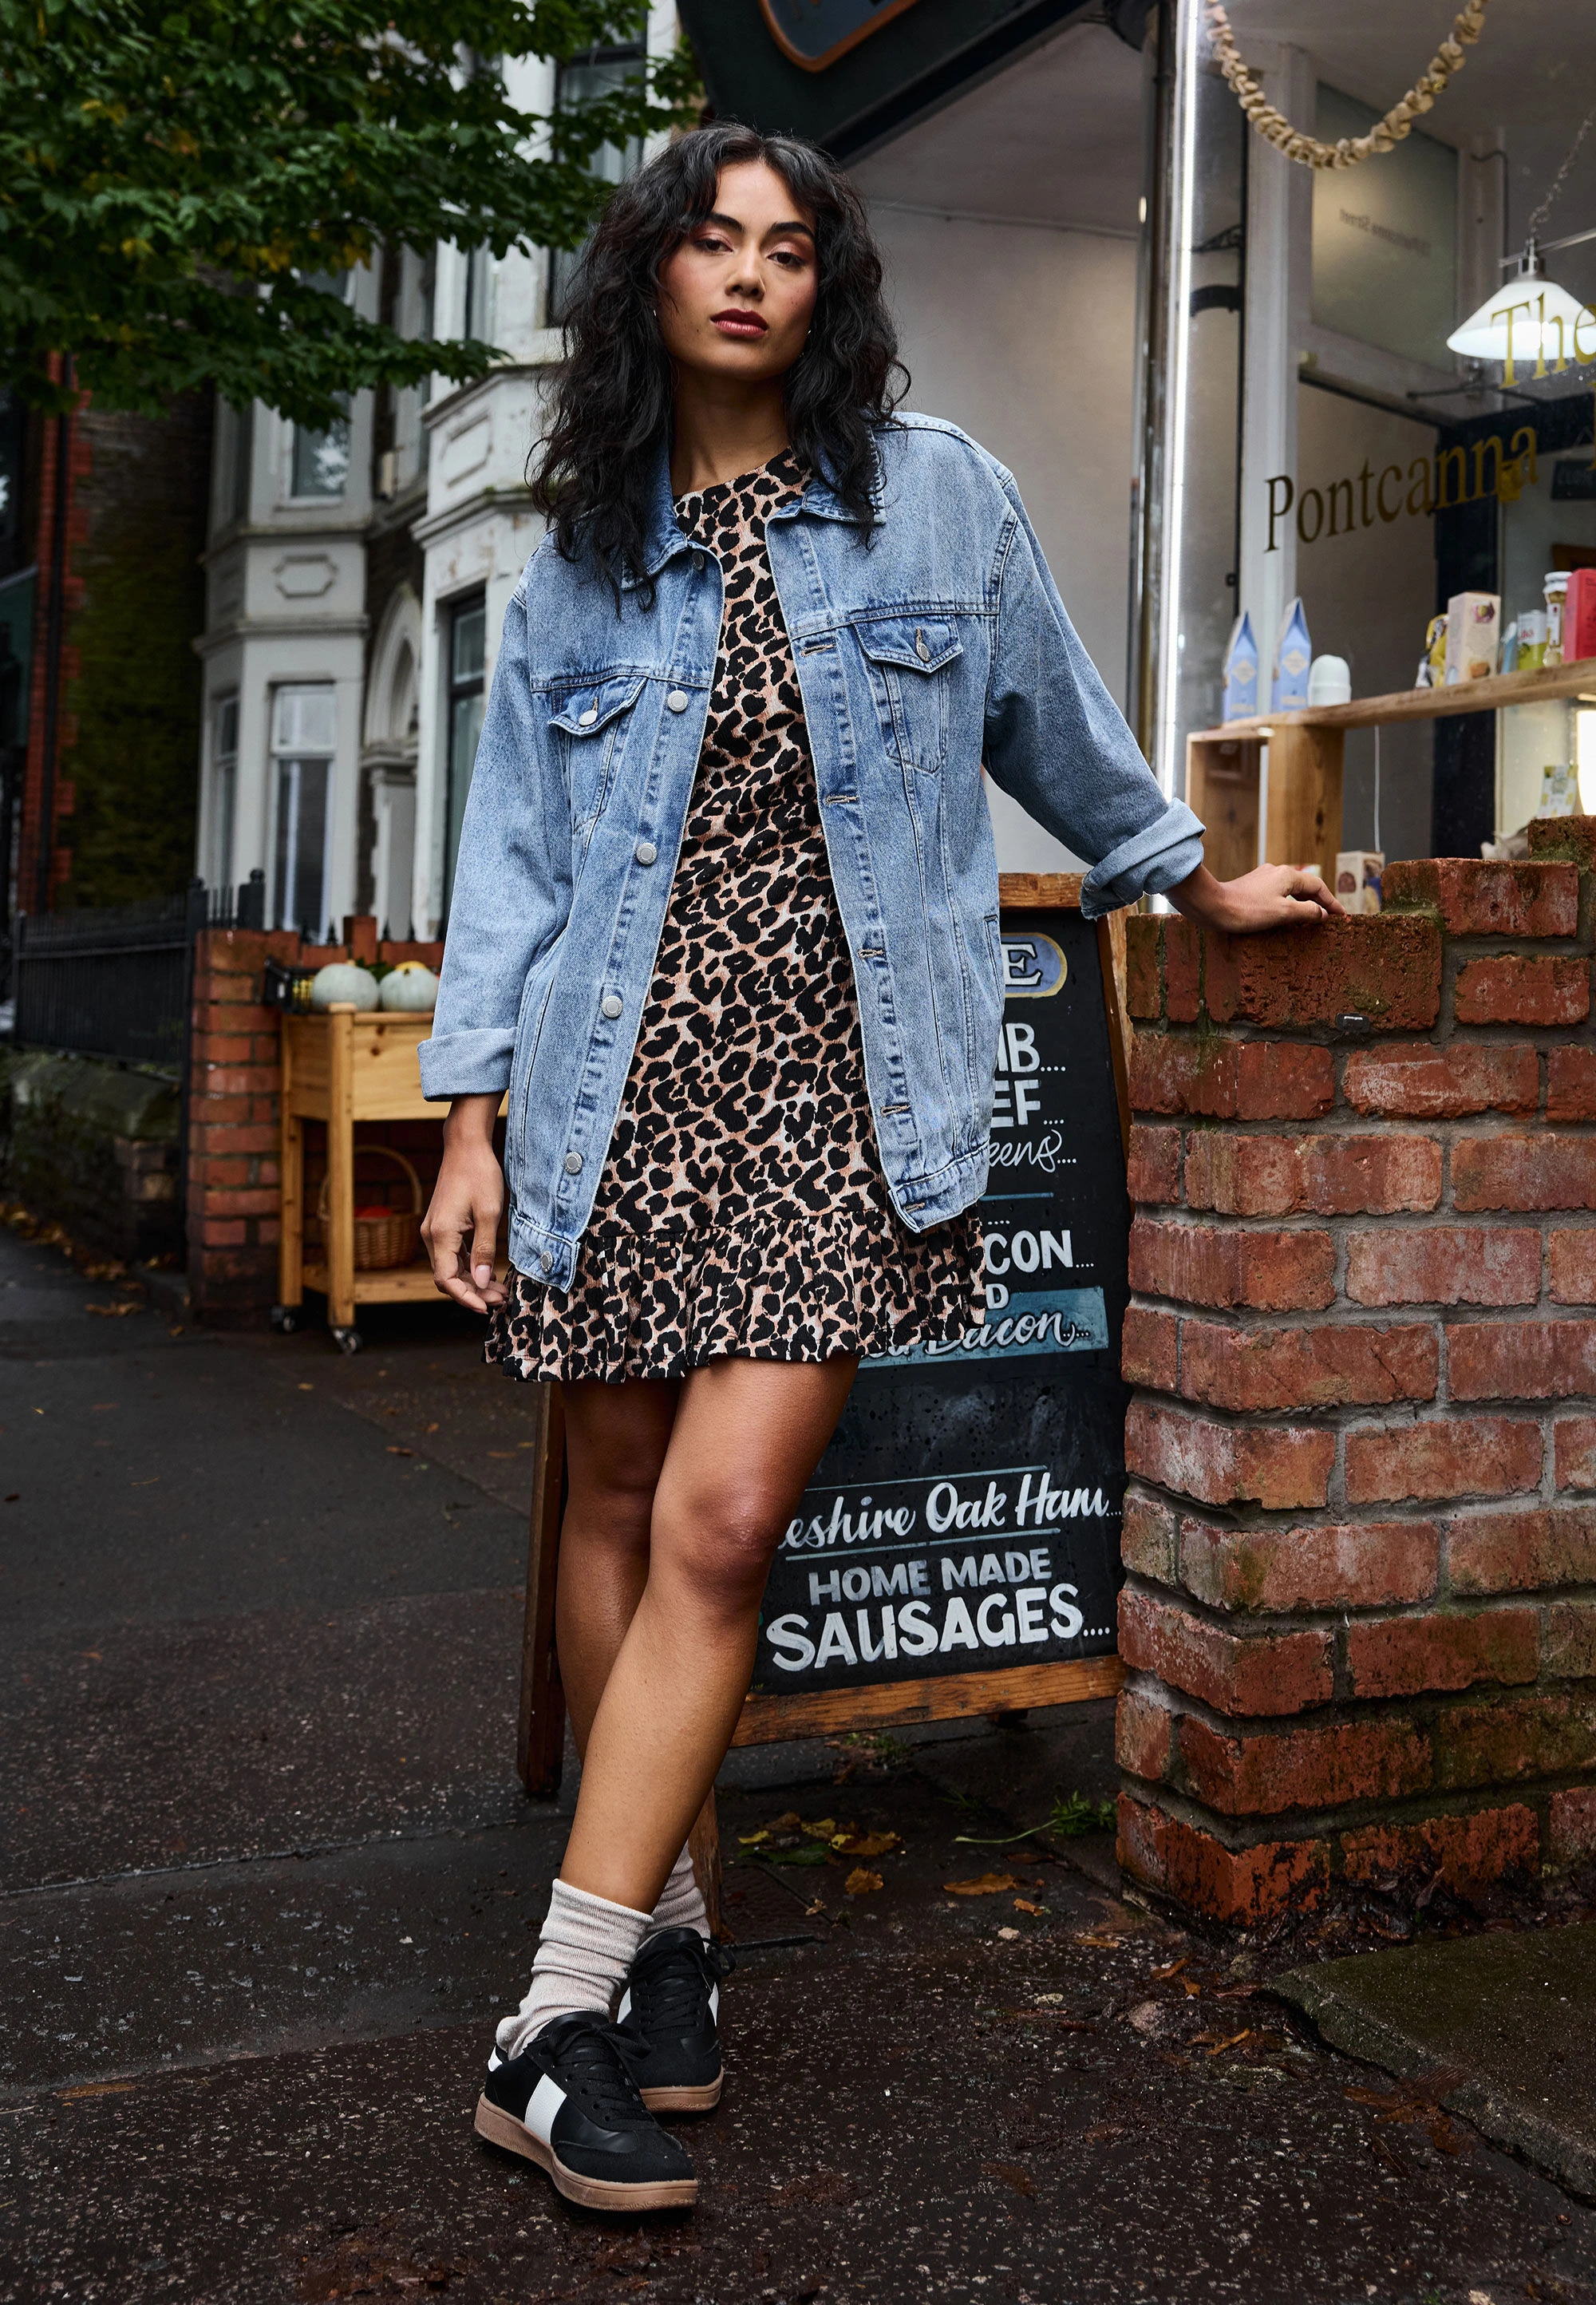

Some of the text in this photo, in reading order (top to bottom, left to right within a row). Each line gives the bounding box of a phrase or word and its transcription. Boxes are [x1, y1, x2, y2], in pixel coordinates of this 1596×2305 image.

[1489, 291, 1596, 390] The
[1263, 427, 1539, 554] Pontcanna
[925, 1482, 1007, 1533] Oak
[808, 1548, 1053, 1606] HOME MADE
